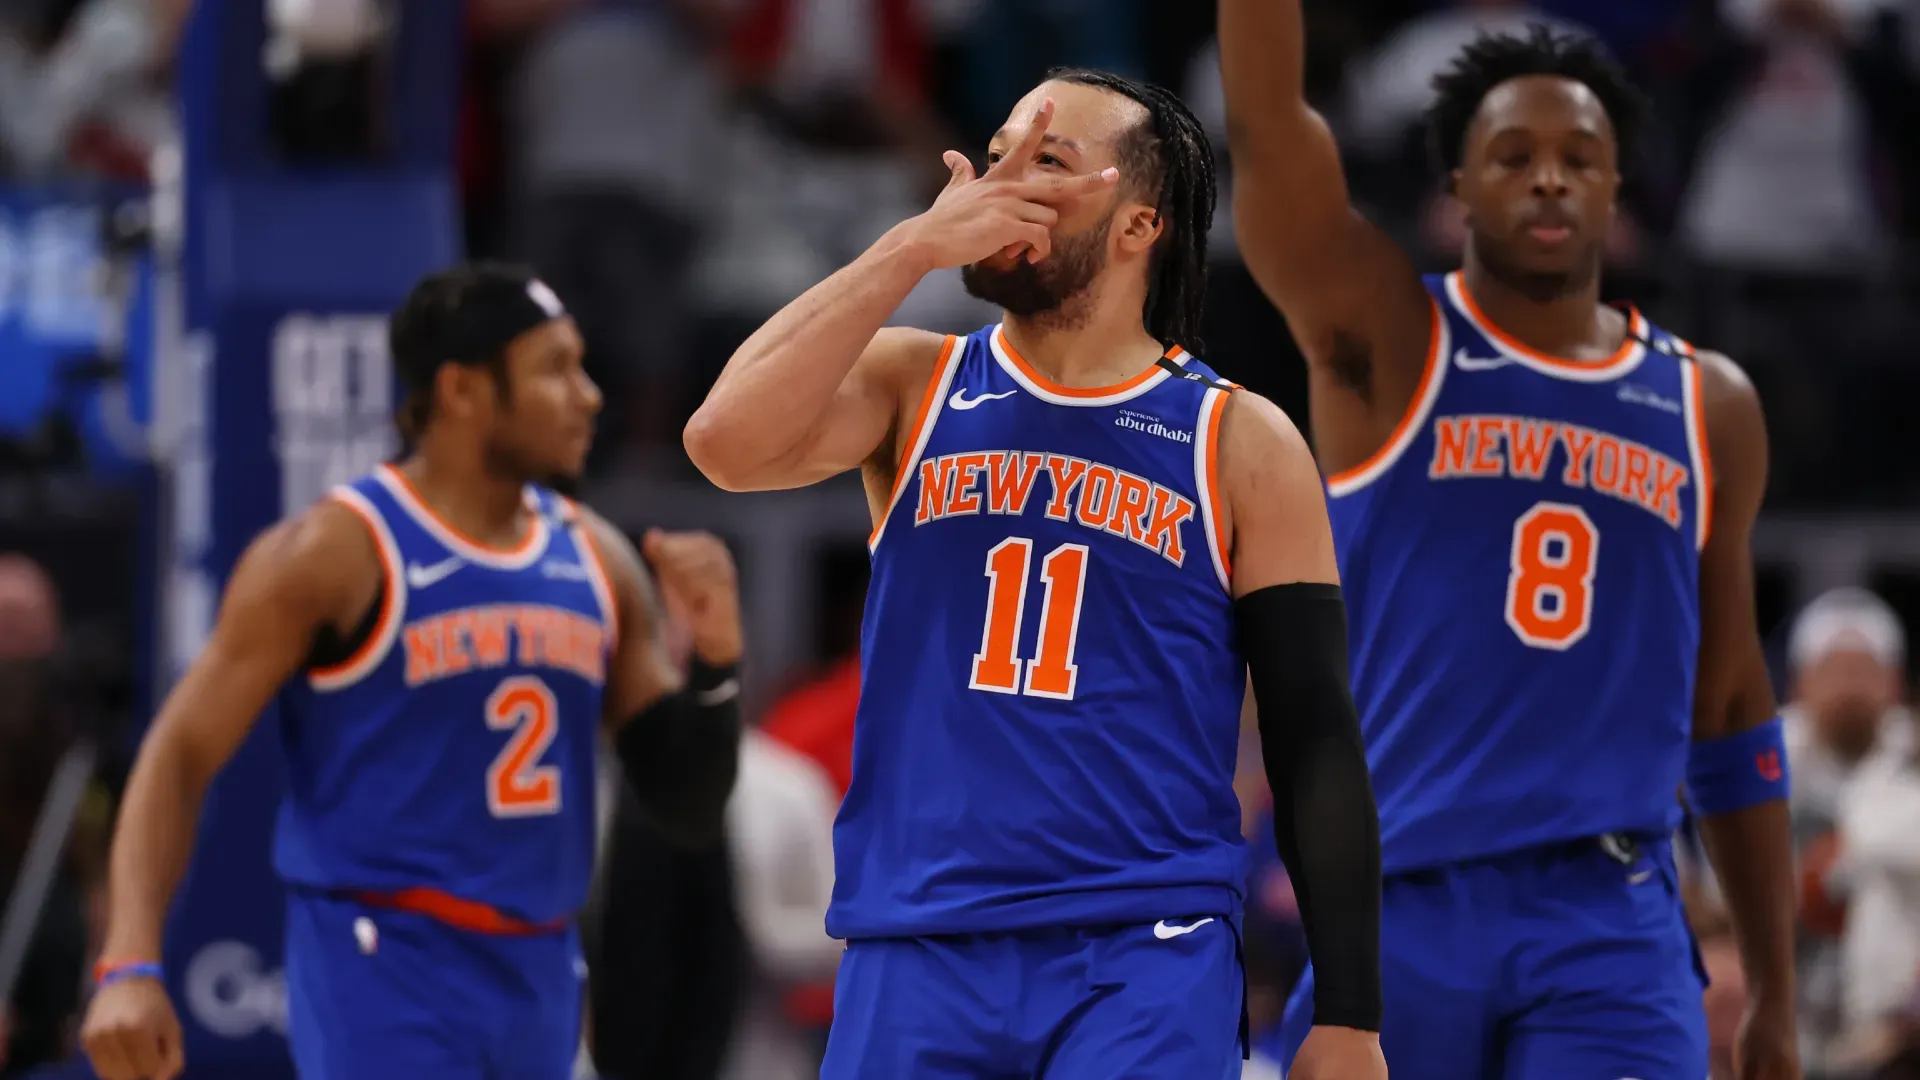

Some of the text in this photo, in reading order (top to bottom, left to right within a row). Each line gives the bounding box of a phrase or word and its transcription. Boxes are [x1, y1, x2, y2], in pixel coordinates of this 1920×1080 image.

[1115, 416, 1145, 432] abu
[1119, 409, 1160, 422] experience
[1429, 415, 1689, 529] NEW YORK
[914, 450, 1196, 568] NEW YORK
[968, 536, 1089, 700] 11
[1505, 501, 1599, 650] 8
[404, 604, 511, 688] NEW
[485, 675, 561, 818] 2
